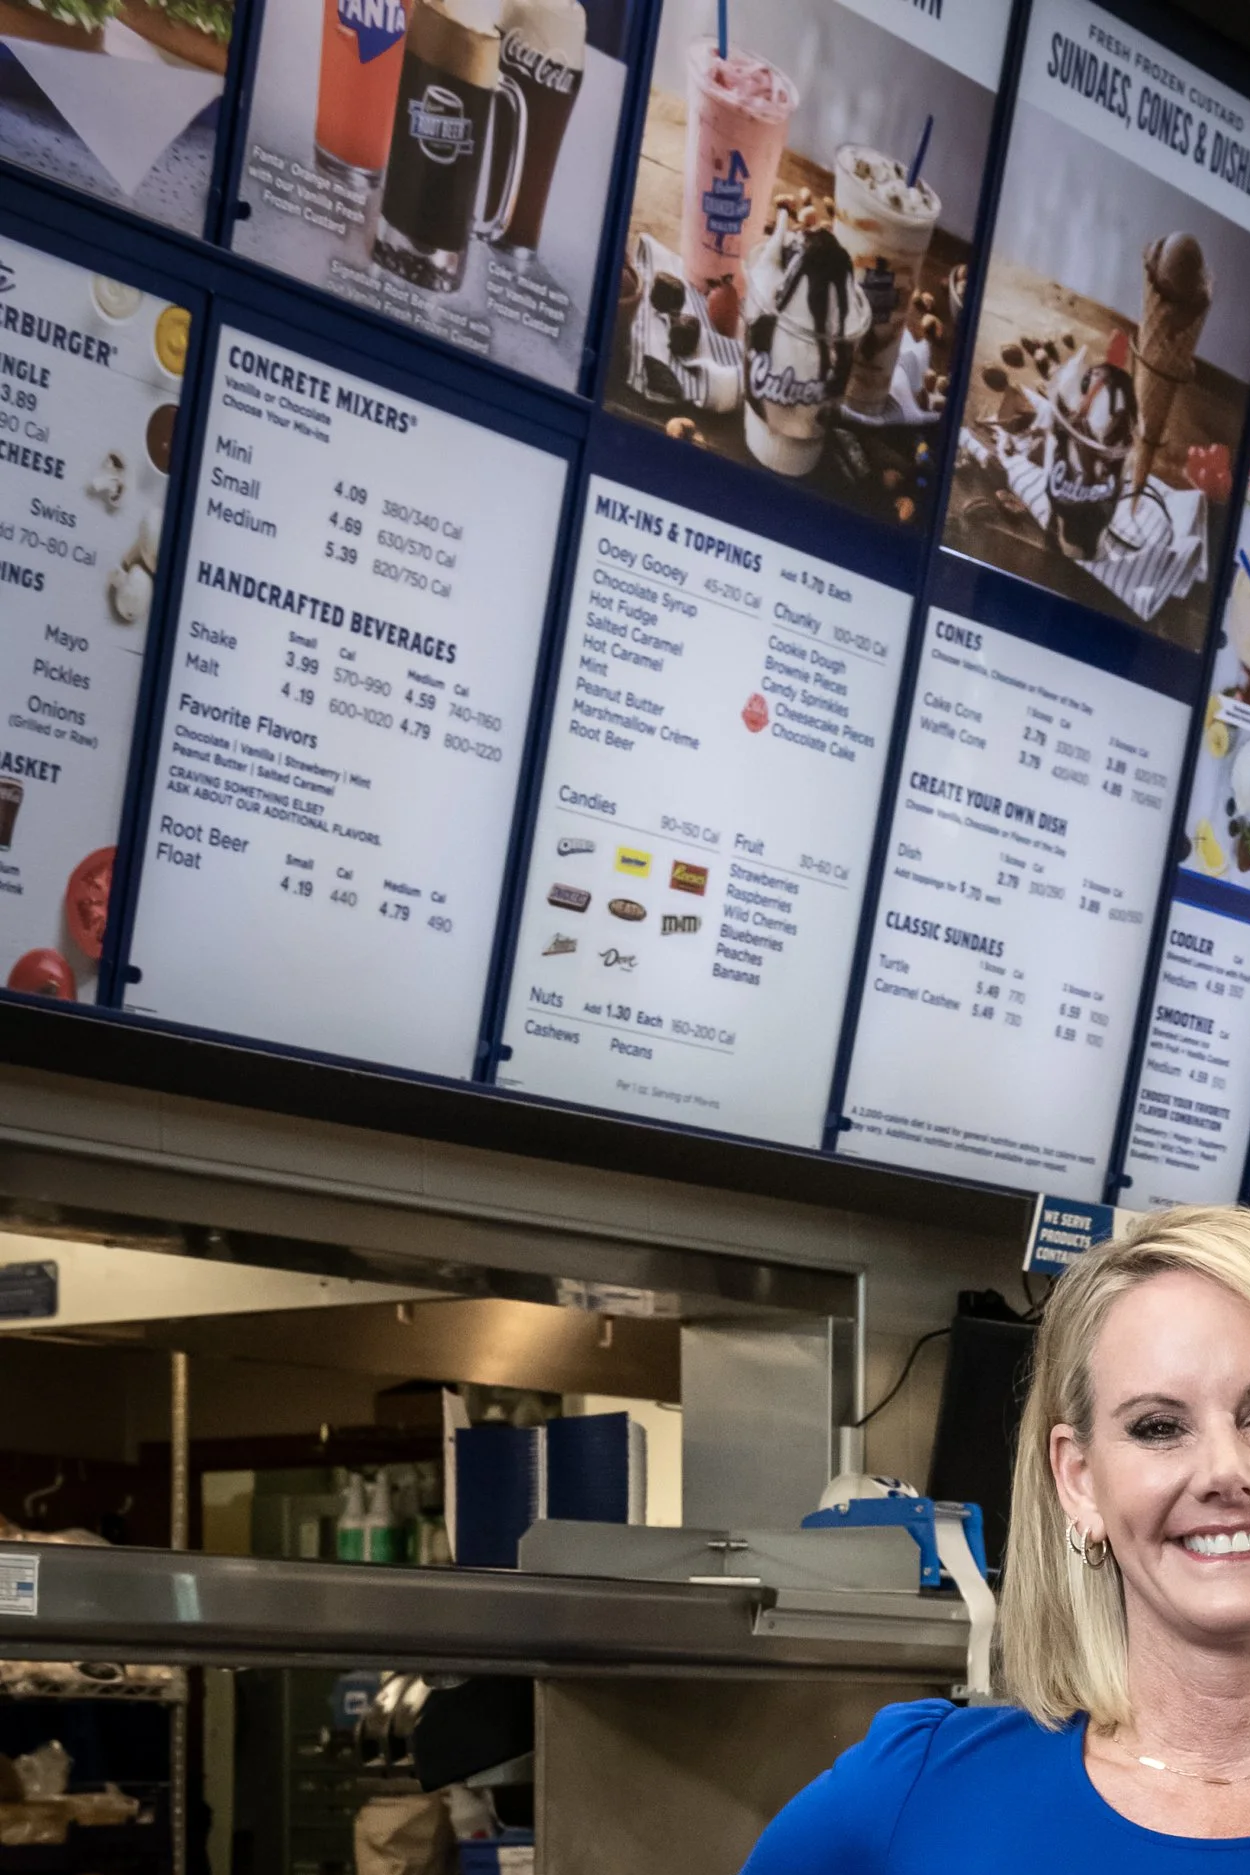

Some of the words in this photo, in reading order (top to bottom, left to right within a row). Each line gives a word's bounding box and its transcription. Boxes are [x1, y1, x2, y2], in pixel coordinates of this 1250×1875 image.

[338, 0, 406, 33] ANTA
[1089, 25, 1131, 62] FRESH
[1135, 50, 1185, 94] FROZEN
[1189, 80, 1243, 133] CUSTARD
[1049, 32, 1133, 129] SUNDAES,
[1137, 89, 1193, 156] CONES
[1195, 124, 1207, 166] &
[0, 354, 51, 390] NGLE
[229, 345, 331, 404] CONCRETE
[0, 382, 37, 412] 3.89
[25, 421, 49, 444] Cal
[0, 438, 66, 480] CHEESE
[216, 435, 252, 465] Mini
[212, 467, 260, 500] Small
[334, 480, 368, 505] 4.09
[30, 498, 77, 528] Swiss
[207, 498, 277, 538] Medium
[329, 511, 363, 536] 4.69
[20, 528, 68, 558] 70-80
[72, 543, 97, 567] Cal
[595, 495, 663, 536] MIX-INS
[667, 523, 678, 542] &
[684, 528, 762, 574] TOPPINGS
[325, 541, 358, 565] 5.39
[599, 538, 637, 567] Ooey
[642, 553, 688, 586] Gooey
[0, 557, 45, 592] INGS
[589, 591, 612, 610] Hot
[619, 600, 658, 627] Fudge
[593, 569, 657, 604] Chocolate
[663, 591, 697, 618] Syrup
[199, 561, 345, 628] HANDCRAFTED
[351, 610, 457, 663] BEVERAGES
[774, 602, 821, 634] Chunky
[44, 624, 90, 653] Mayo
[189, 621, 237, 651] Shake
[285, 650, 319, 676] 3.99
[586, 612, 627, 639] Salted
[632, 627, 684, 657] Caramel
[935, 620, 982, 651] CONES
[185, 652, 219, 678] Malt
[579, 656, 609, 678] Mint
[583, 634, 607, 653] Hot
[611, 643, 664, 673] Caramel
[33, 658, 90, 689] Pickles
[407, 669, 445, 690] Medium
[27, 695, 87, 727] Onions
[576, 678, 621, 705] Peanut
[625, 693, 665, 717] Butter
[923, 692, 952, 713] Cake
[955, 702, 982, 723] Cone
[8, 713, 51, 737] (Grilled
[68, 729, 98, 750] Raw)
[180, 693, 251, 732] Favorite
[257, 712, 317, 750] Flavors
[573, 699, 656, 737] Marshmallow
[920, 716, 956, 739] Waffle
[959, 730, 986, 750] Cone
[569, 720, 599, 743] Root
[604, 731, 635, 753] Beer
[829, 742, 856, 763] Cake
[0, 751, 62, 784] ASKET
[173, 741, 210, 763] Peanut
[213, 751, 248, 773] Butter
[257, 763, 290, 785] Salted
[175, 723, 230, 751] Chocolate
[241, 740, 275, 764] Vanilla
[285, 753, 341, 783] Strawberry
[349, 771, 372, 789] Mint
[167, 779, 190, 798] ASK
[194, 786, 234, 808] ABOUT
[236, 797, 261, 816] OUR
[264, 802, 330, 833] ADDITIONAL
[169, 765, 222, 791] CRAVING
[225, 779, 290, 808] SOMETHING
[292, 795, 325, 816] ELSE?
[560, 784, 617, 816] Candies
[910, 771, 964, 803] CREATE
[966, 789, 1001, 815] YOUR
[1006, 802, 1034, 826] OWN
[1039, 811, 1068, 836] DISH
[161, 815, 203, 845] Root
[208, 826, 249, 854] Beer
[735, 833, 765, 855] Fruit
[156, 841, 201, 870] Float
[898, 842, 922, 862] Dish
[384, 877, 422, 899] Medium
[729, 864, 800, 896] Strawberries
[726, 884, 792, 914] Raspberries
[720, 924, 783, 953] Blueberries
[886, 911, 940, 941] CLASSIC
[944, 927, 1004, 958] SUNDAES
[1170, 930, 1214, 956] COOLER
[716, 943, 762, 967] Peaches
[880, 954, 910, 974] Turtle
[712, 963, 760, 986] Bananas
[531, 986, 563, 1009] Nuts
[606, 1004, 631, 1022] 1.30
[922, 991, 960, 1011] Cashew
[1156, 1006, 1214, 1035] SMOOTHIE
[525, 1020, 580, 1045] Cashews
[610, 1038, 653, 1060] Pecans
[1040, 1227, 1091, 1248] PRODUCTS
[1061, 1213, 1092, 1231] SERVE
